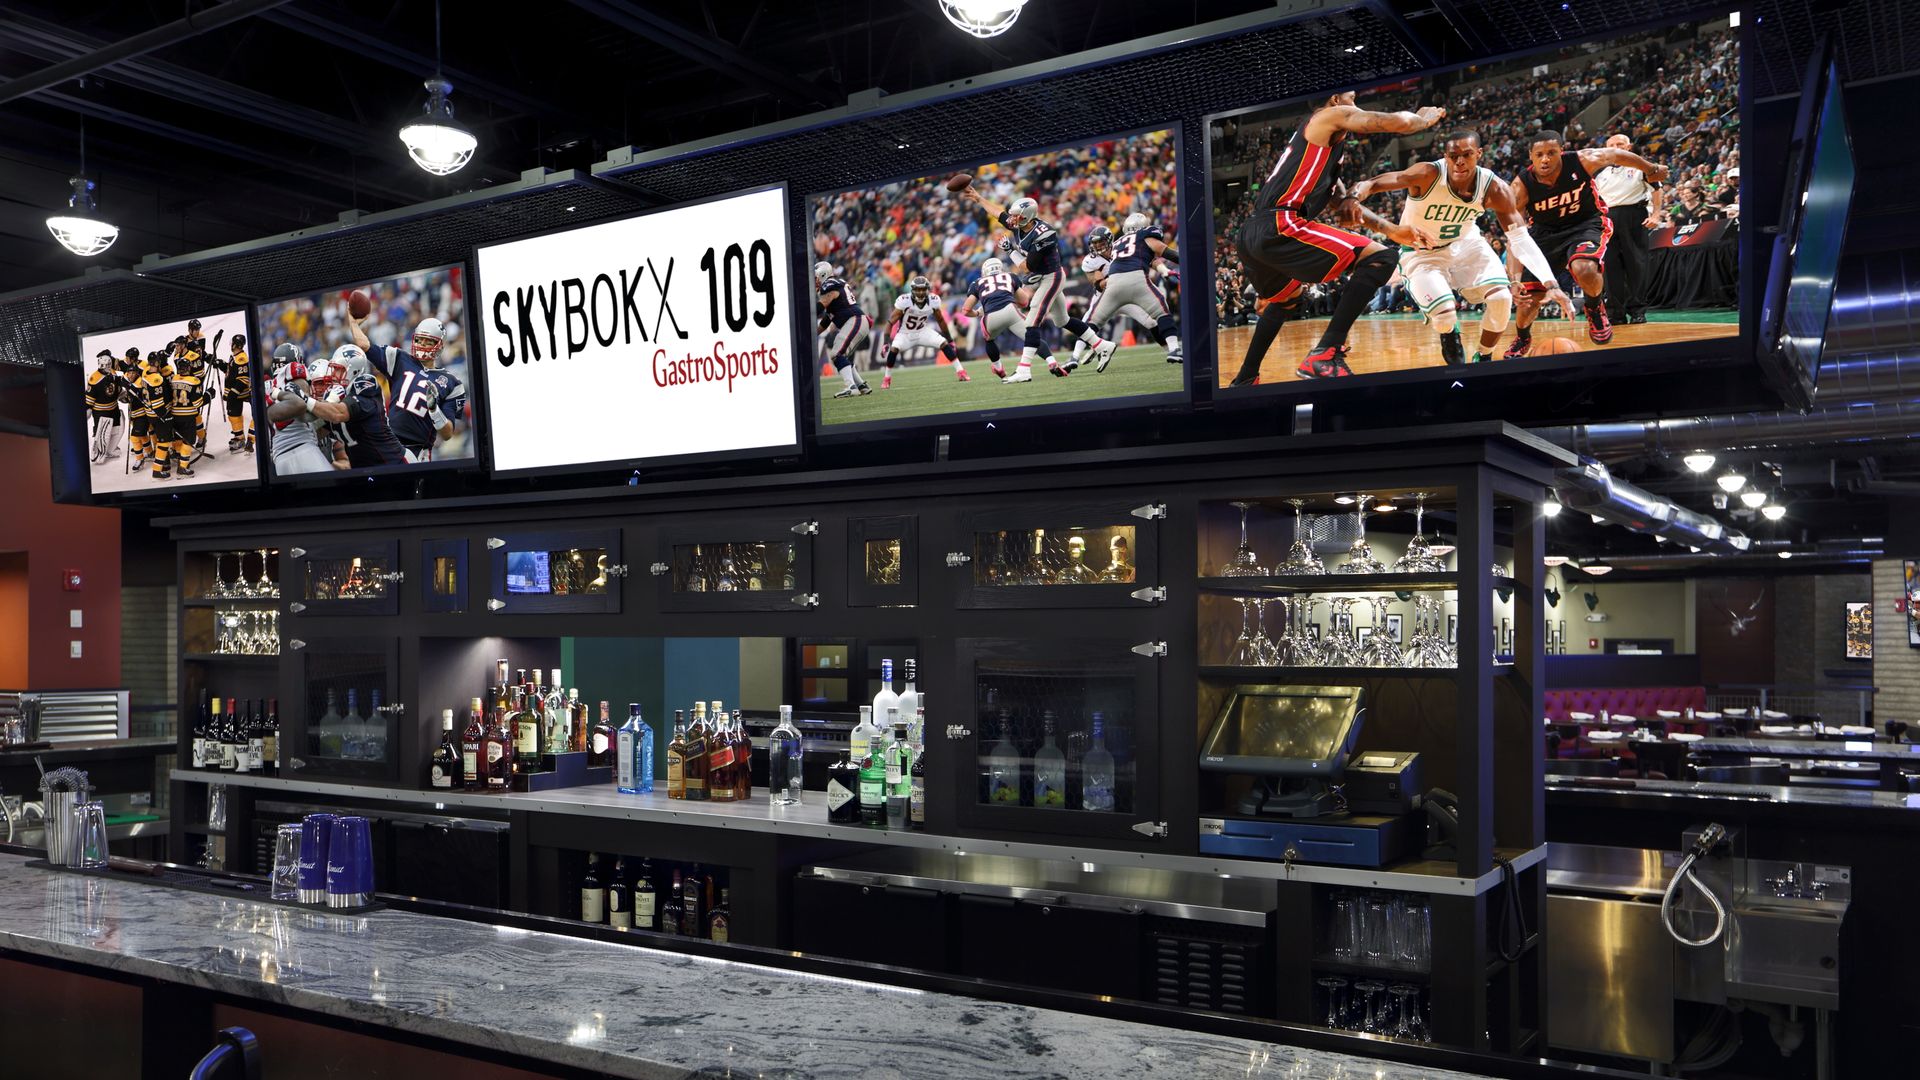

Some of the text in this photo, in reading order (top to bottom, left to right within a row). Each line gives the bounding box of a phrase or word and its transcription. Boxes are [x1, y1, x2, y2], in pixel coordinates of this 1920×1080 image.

[1534, 181, 1586, 212] HEAT
[1559, 202, 1581, 218] 15
[1034, 222, 1050, 237] 12
[1438, 224, 1463, 240] 9
[700, 238, 775, 333] 109
[978, 272, 1013, 297] 39
[906, 315, 928, 330] 52
[652, 341, 778, 393] GastroSports
[395, 370, 430, 418] 12
